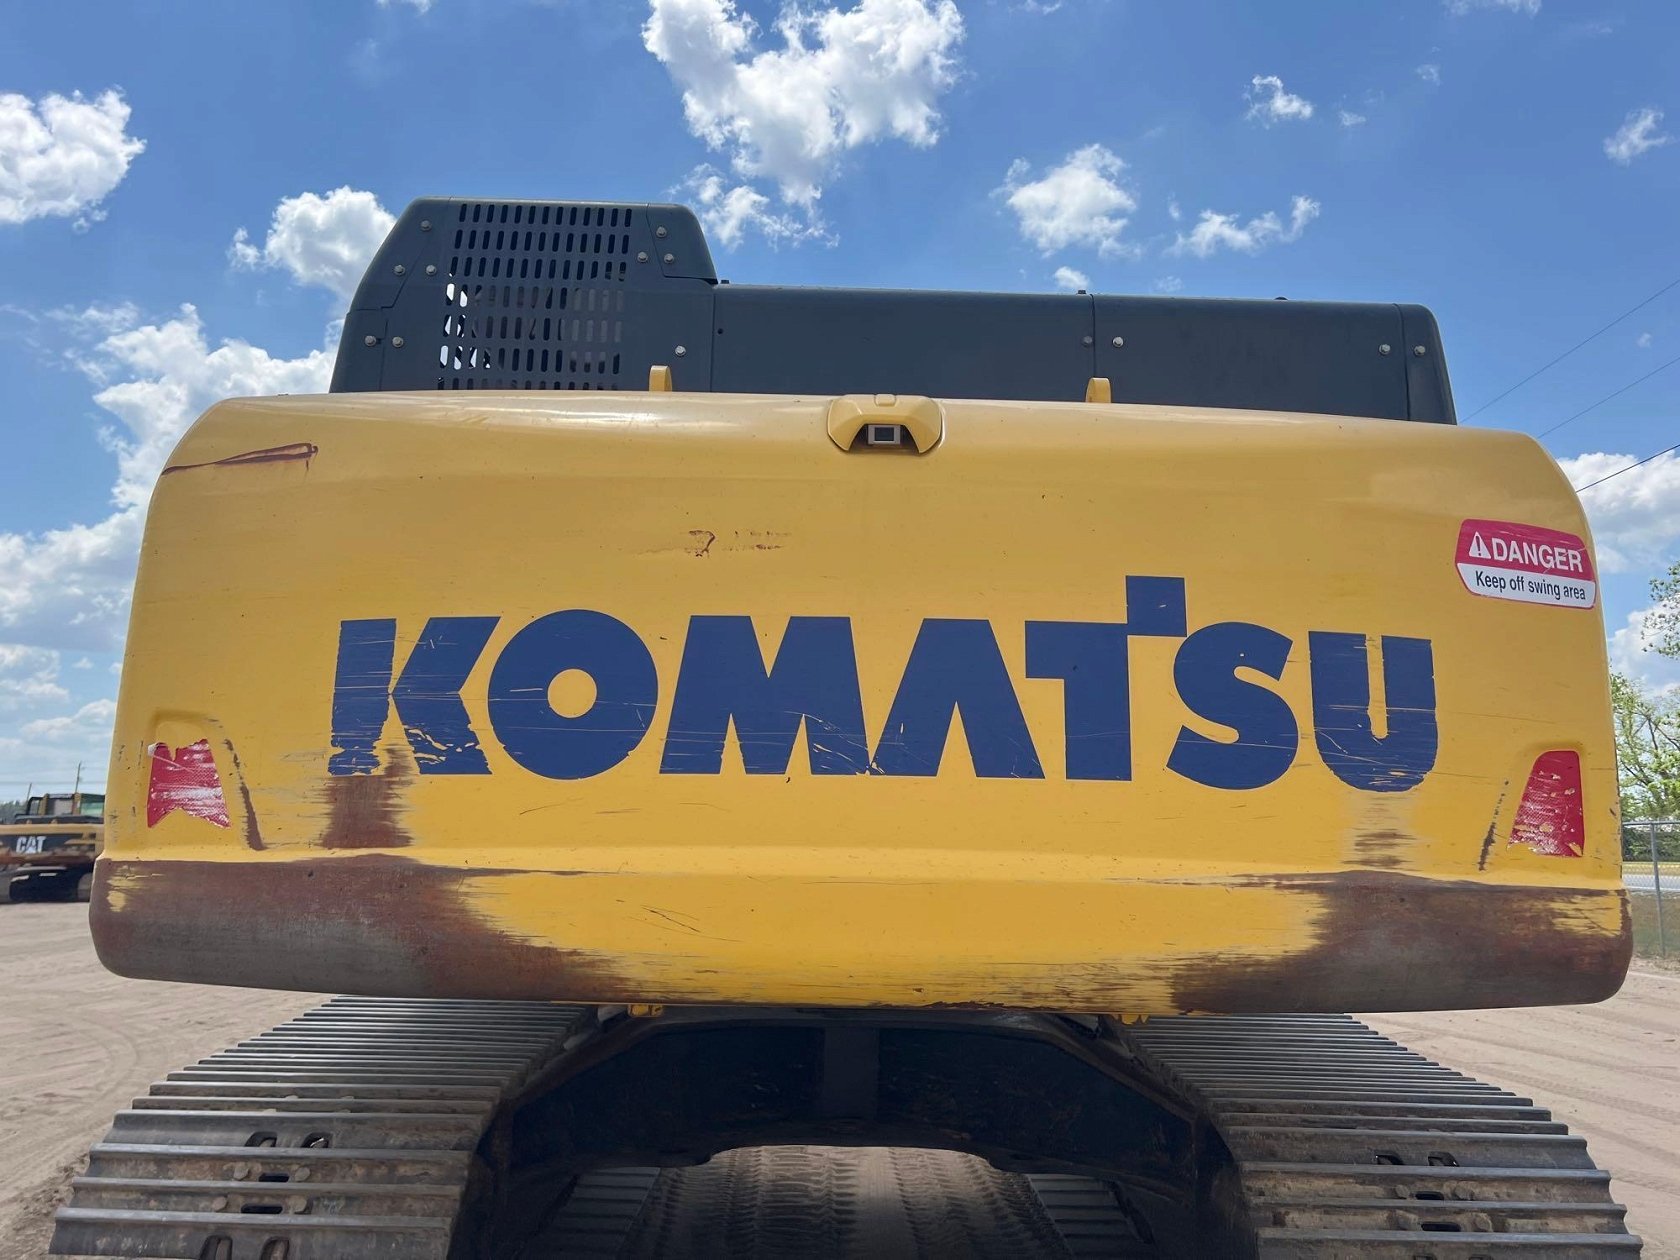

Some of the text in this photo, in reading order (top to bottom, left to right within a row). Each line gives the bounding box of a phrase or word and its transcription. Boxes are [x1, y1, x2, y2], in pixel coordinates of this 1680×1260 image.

[1491, 537, 1583, 573] DANGER
[1475, 570, 1586, 600] Keep off swing area
[328, 575, 1438, 792] KOMATSU
[16, 836, 47, 854] CAT
